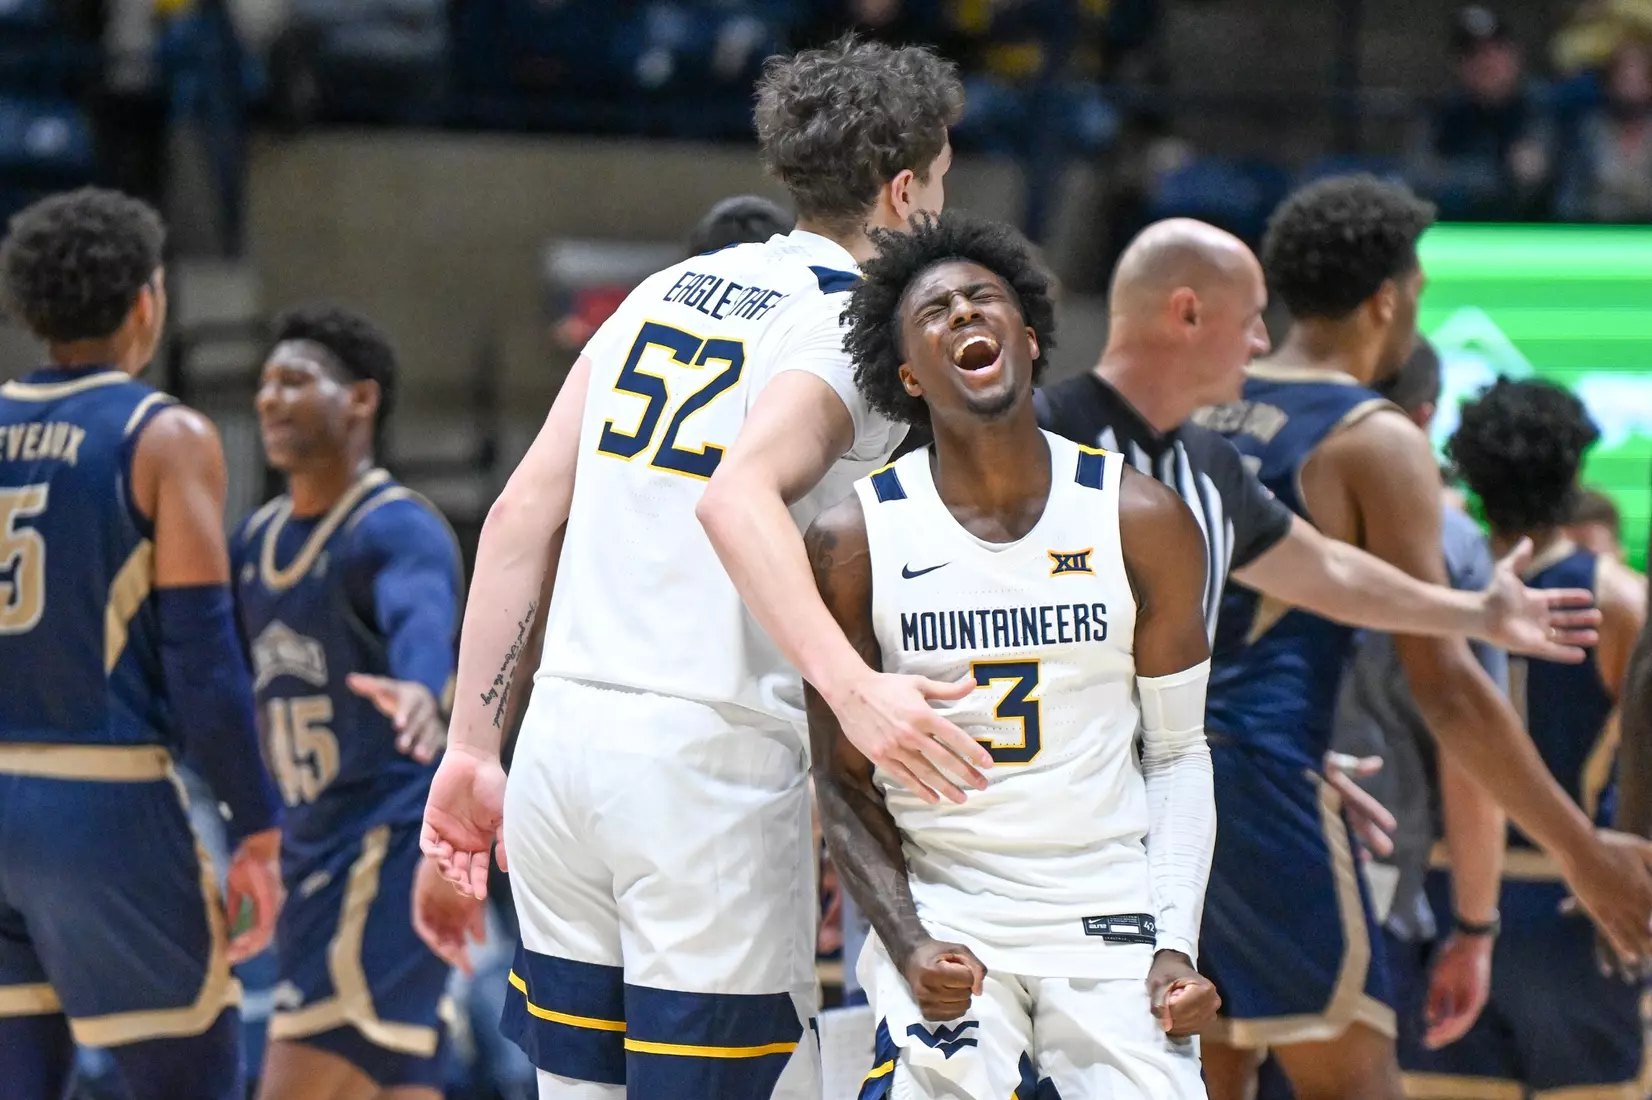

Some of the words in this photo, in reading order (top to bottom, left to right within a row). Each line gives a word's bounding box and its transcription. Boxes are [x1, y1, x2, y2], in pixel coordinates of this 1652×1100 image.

[663, 271, 791, 320] EAGLETAFF
[596, 318, 746, 482] 52
[0, 483, 49, 634] 5
[1048, 548, 1094, 576] XII
[900, 603, 1108, 651] MOUNTAINEERS
[268, 695, 341, 807] 15
[970, 658, 1044, 766] 3
